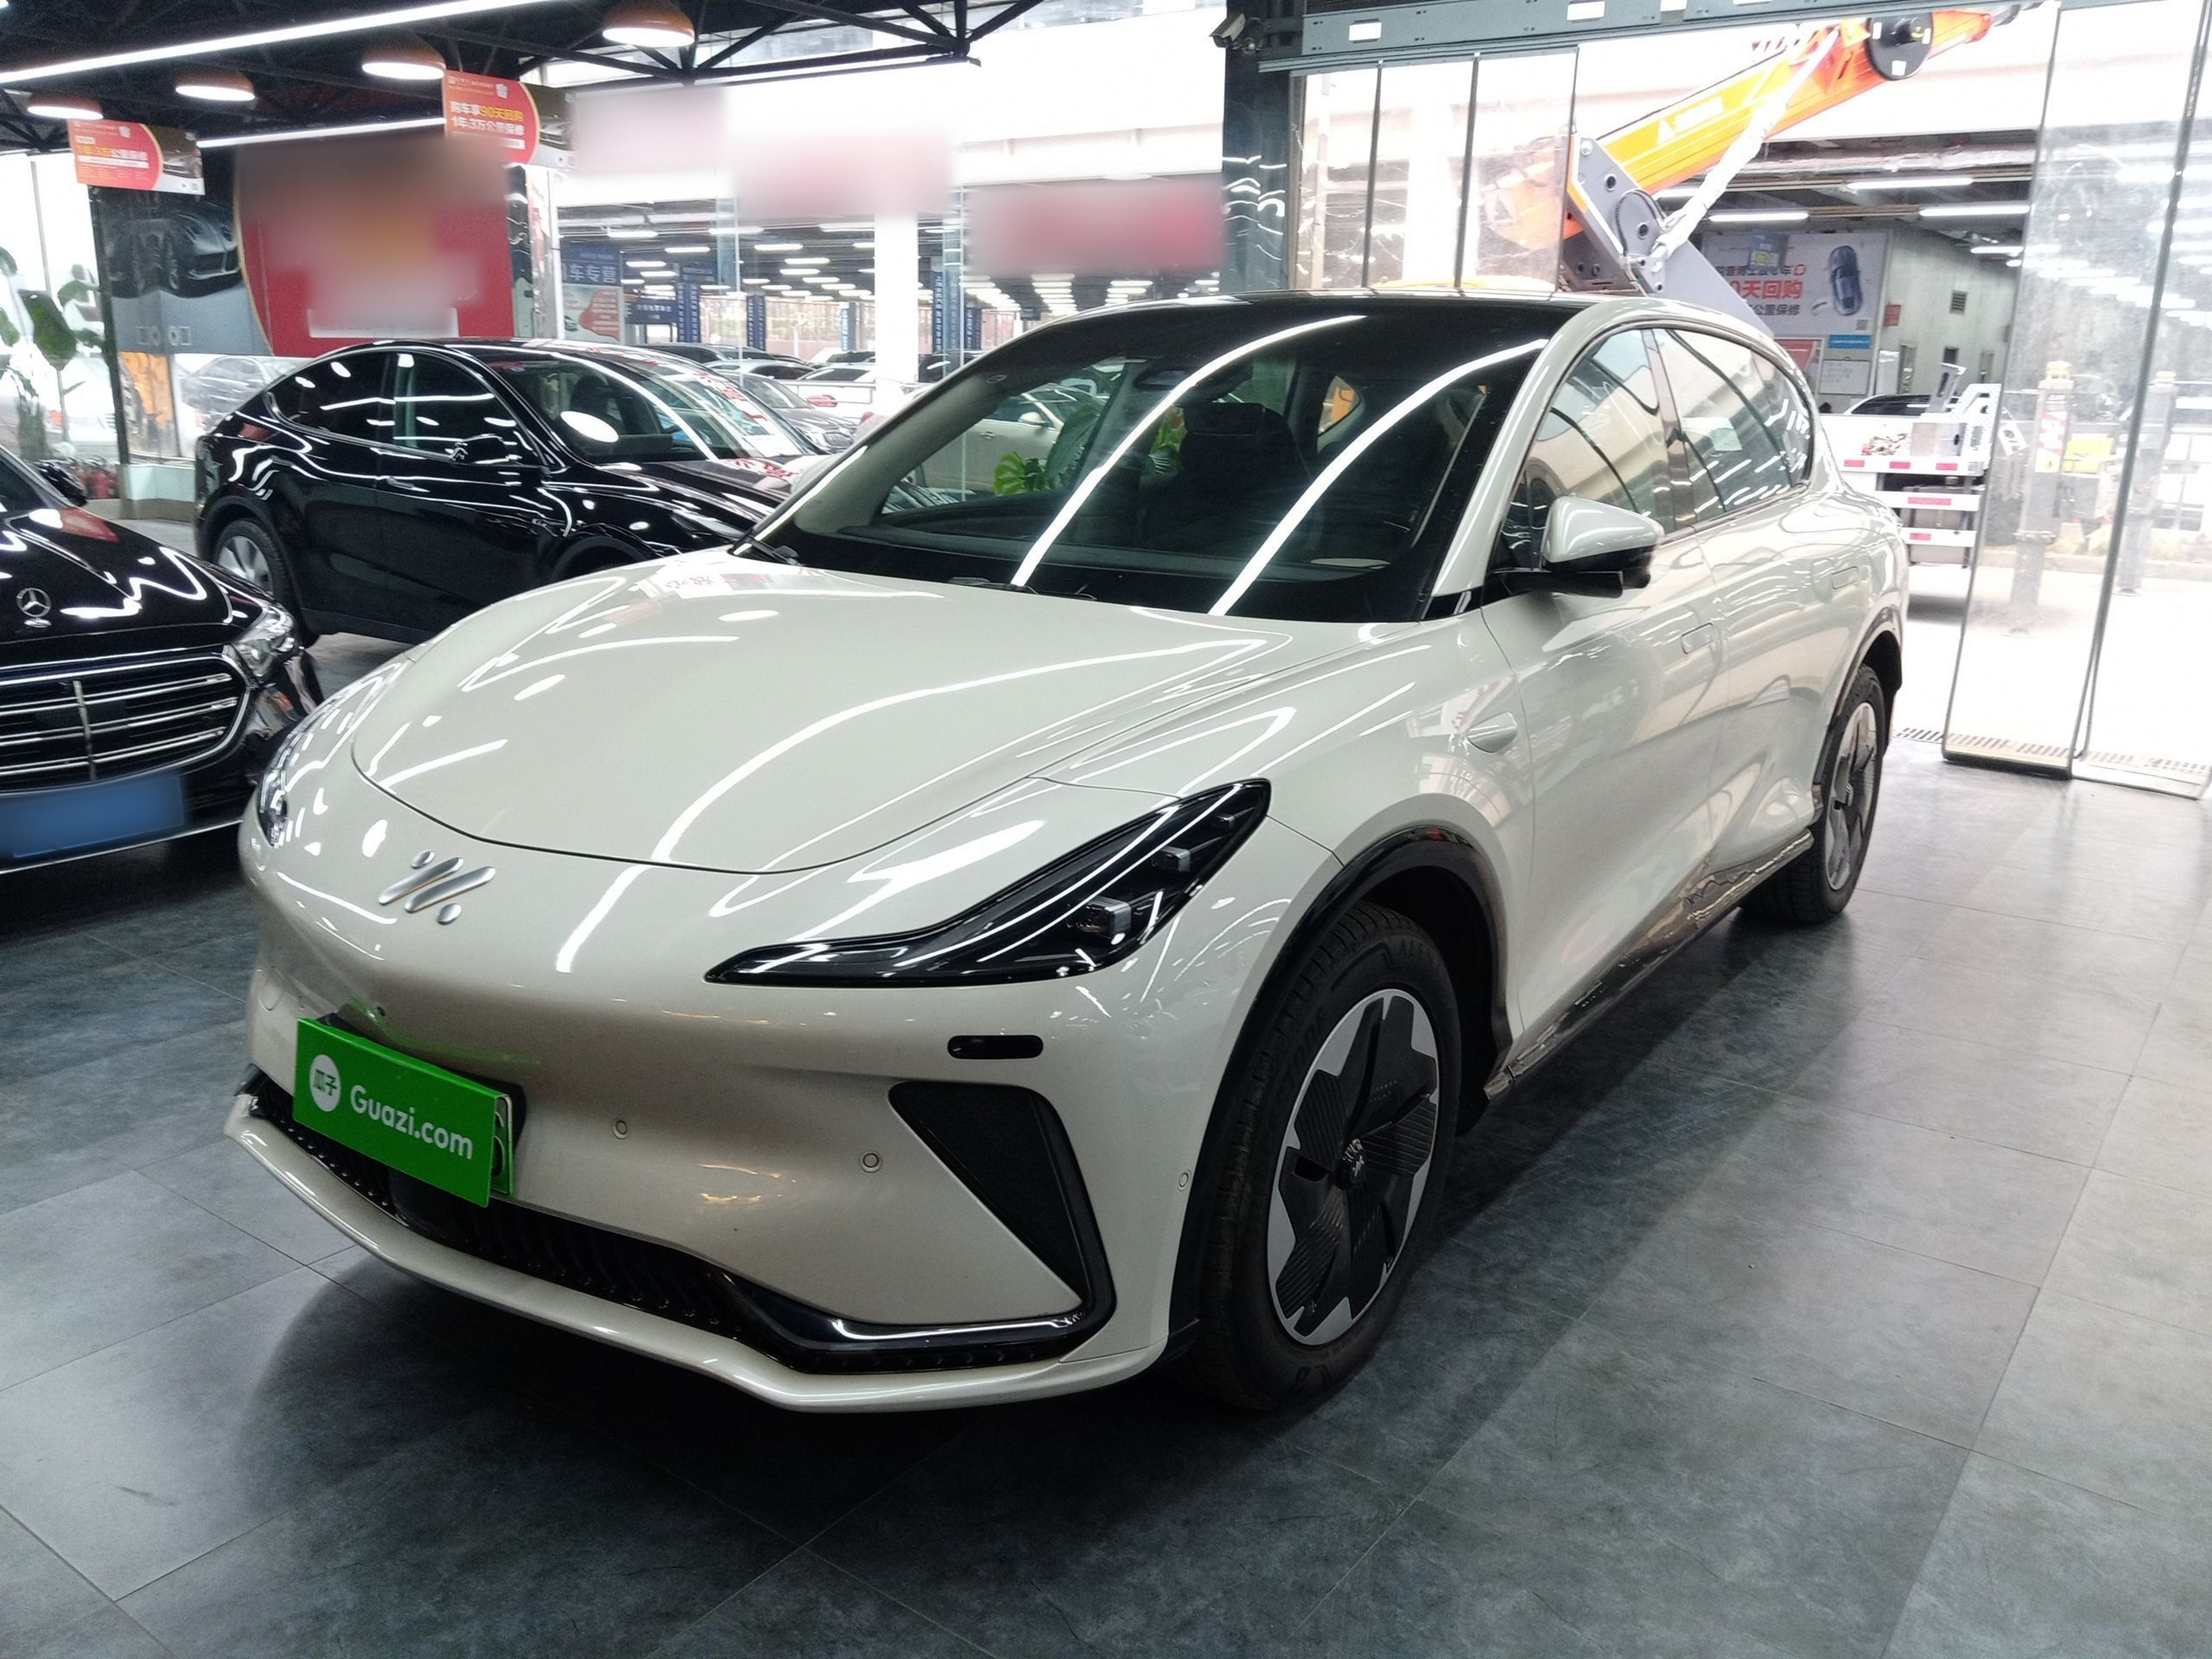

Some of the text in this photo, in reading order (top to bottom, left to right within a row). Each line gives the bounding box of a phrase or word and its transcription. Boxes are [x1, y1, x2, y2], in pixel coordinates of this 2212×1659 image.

[563, 263, 616, 284] 车专营
[1750, 303, 1801, 316] 公里保修
[350, 1084, 473, 1160] Guazi.com
